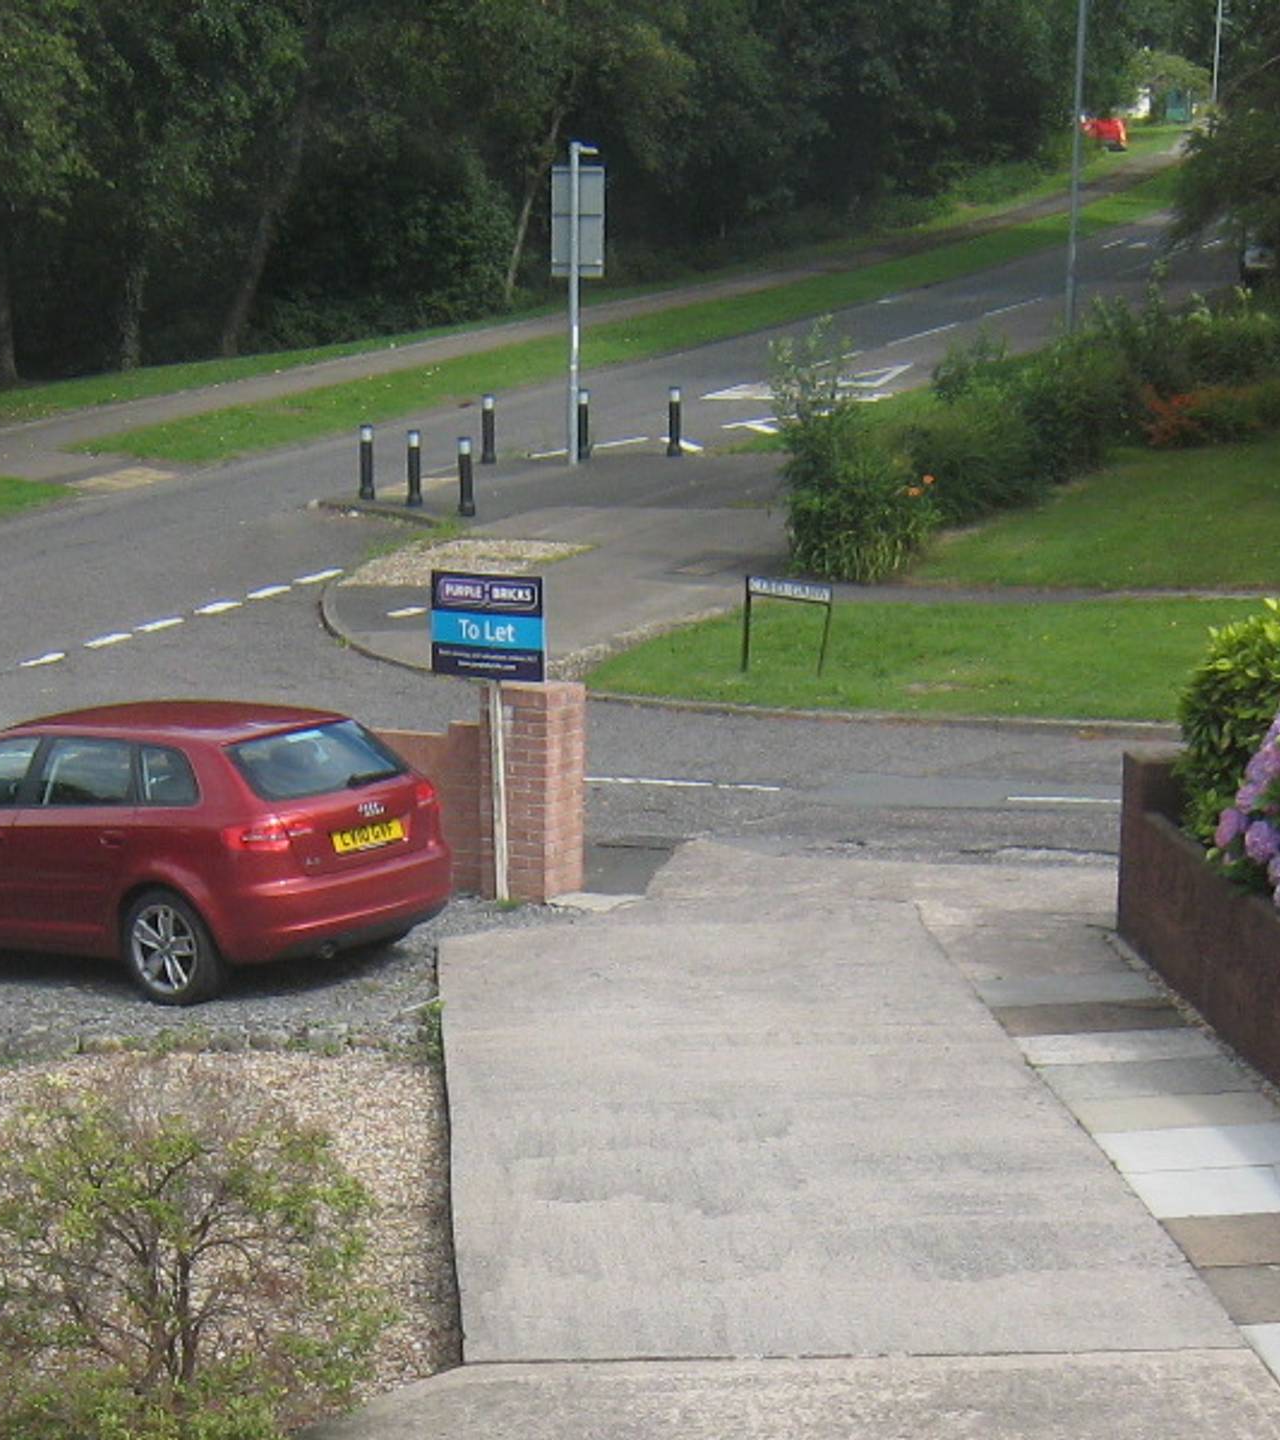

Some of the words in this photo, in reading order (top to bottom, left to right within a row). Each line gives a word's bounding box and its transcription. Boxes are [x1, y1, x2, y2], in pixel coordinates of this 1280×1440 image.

[444, 583, 482, 599] PURPLE
[492, 587, 532, 601] BRICKS
[458, 618, 479, 639] To
[485, 620, 515, 642] Let
